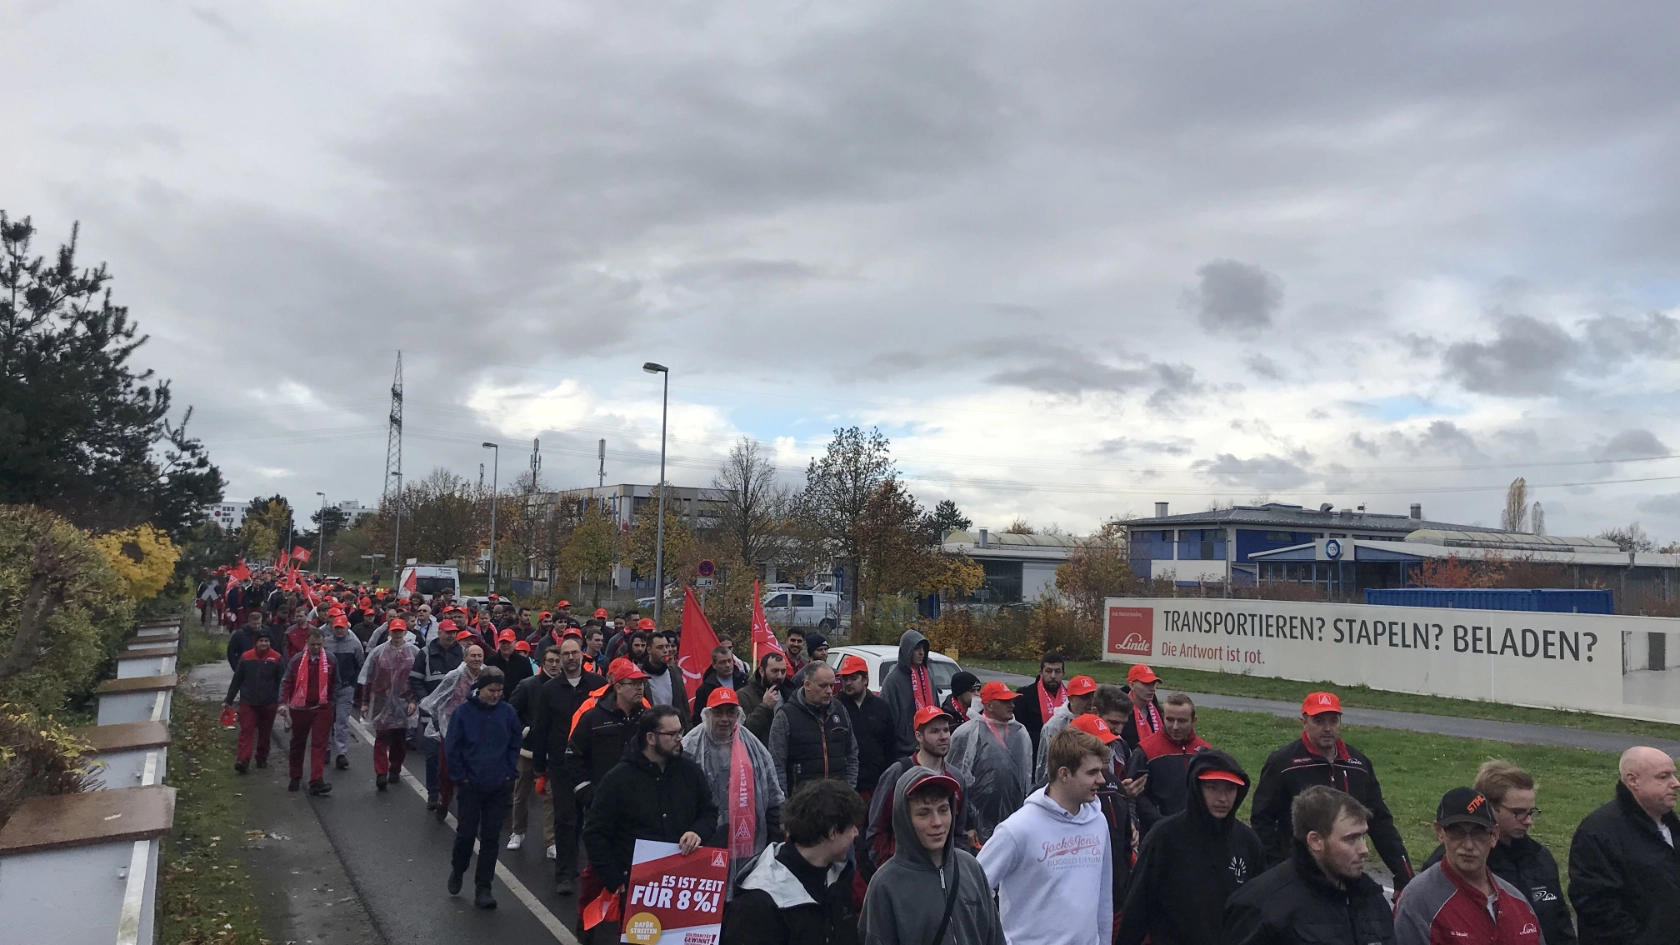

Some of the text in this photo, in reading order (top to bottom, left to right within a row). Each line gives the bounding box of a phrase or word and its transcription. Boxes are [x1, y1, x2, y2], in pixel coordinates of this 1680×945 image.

[1115, 632, 1150, 652] Linde
[1163, 610, 1599, 663] TRANSPORTIEREN? STAPELN? BELADEN?
[1161, 641, 1266, 665] Die Antwort ist rot.
[1466, 795, 1486, 814] STIHL
[661, 874, 725, 892] ES IST ZEIT
[630, 881, 674, 909] FÜR
